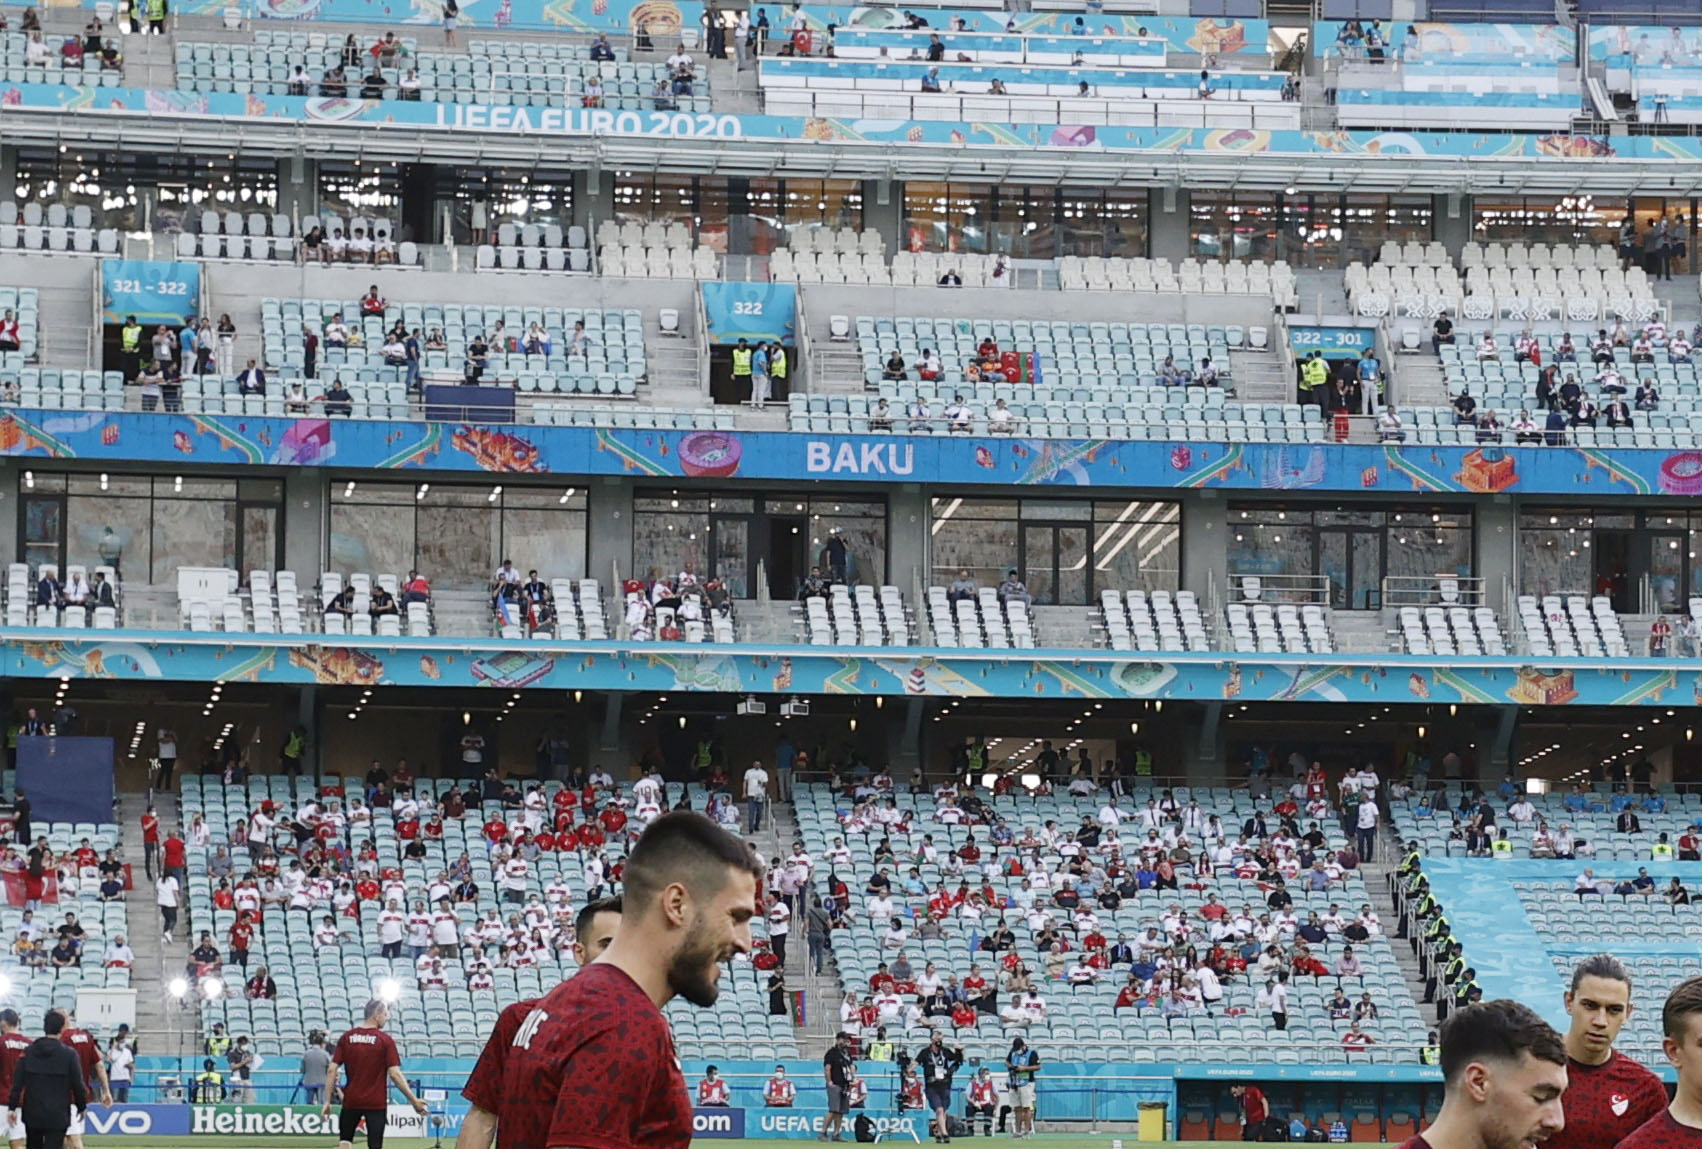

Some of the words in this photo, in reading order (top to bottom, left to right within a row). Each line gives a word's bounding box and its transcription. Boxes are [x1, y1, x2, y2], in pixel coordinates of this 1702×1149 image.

[436, 104, 532, 131] UEFA
[540, 108, 642, 135] EURO
[648, 112, 742, 139] 2020
[113, 279, 141, 293] 321
[157, 281, 187, 295] 322
[734, 301, 763, 315] 322
[1293, 331, 1321, 345] 322
[1335, 332, 1363, 346] 301
[807, 441, 915, 475] BAKU
[192, 1106, 341, 1134] Heineken
[761, 1115, 810, 1132] UEFA
